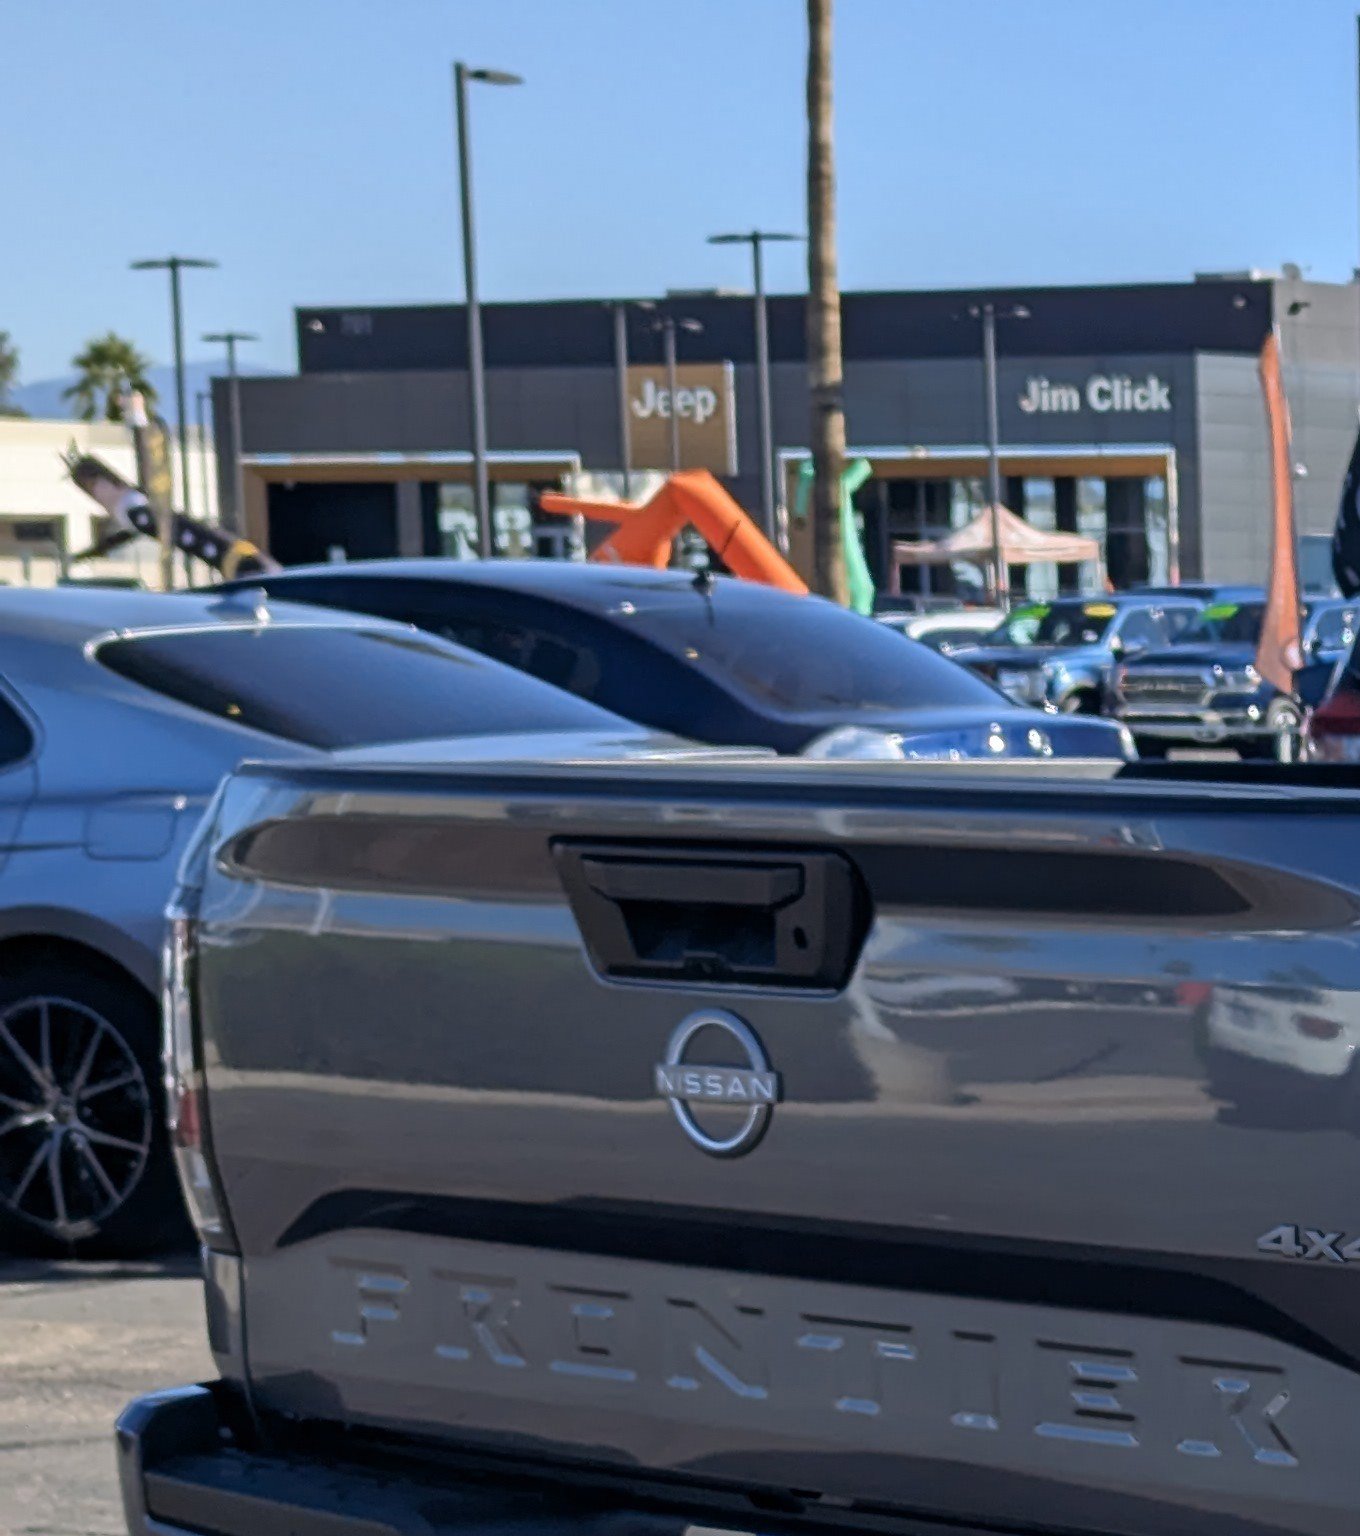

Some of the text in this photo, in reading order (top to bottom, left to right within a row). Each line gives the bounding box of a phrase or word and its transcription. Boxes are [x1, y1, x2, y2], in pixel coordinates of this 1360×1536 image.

[632, 379, 717, 423] Jeep
[1018, 373, 1172, 412] Jim Click
[656, 1067, 774, 1099] NISSAN
[327, 1256, 1300, 1465] FRONTIER
